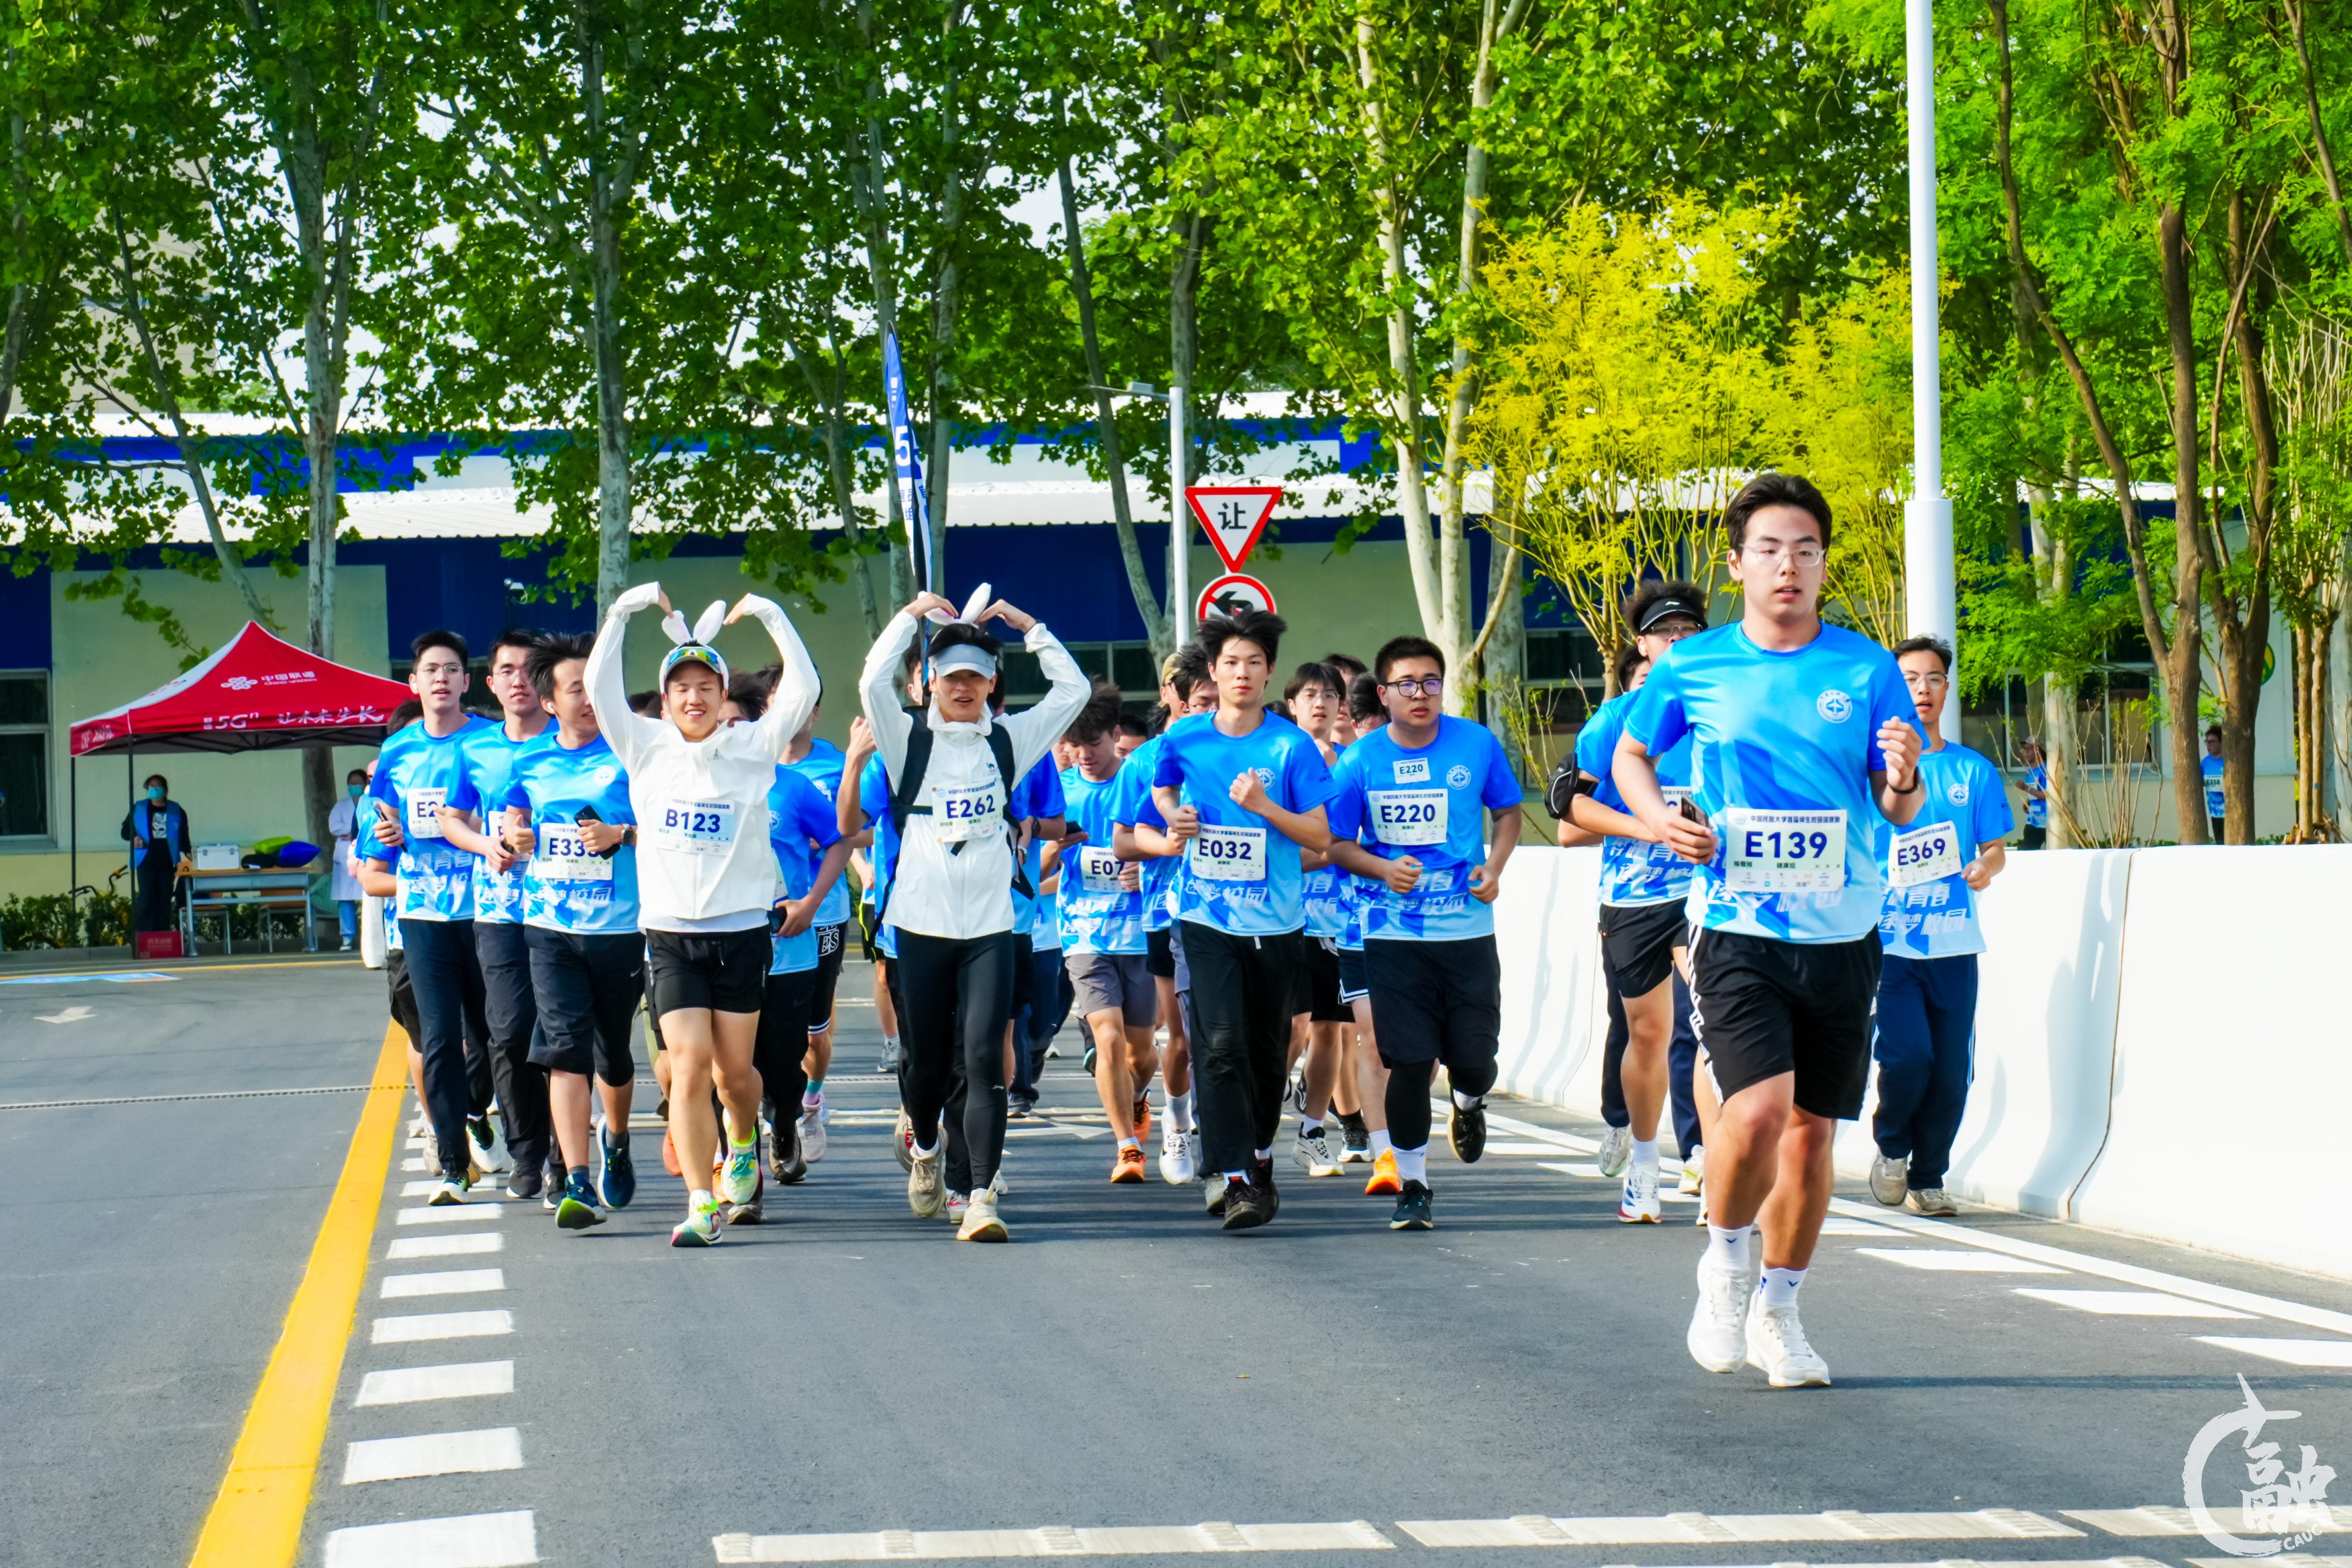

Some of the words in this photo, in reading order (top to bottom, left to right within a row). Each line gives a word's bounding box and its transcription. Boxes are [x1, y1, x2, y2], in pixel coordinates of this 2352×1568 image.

[1218, 502, 1247, 530] 让
[261, 671, 315, 681] 中国联通
[1400, 764, 1423, 774] E220
[417, 801, 447, 817] E2
[946, 794, 995, 819] E262
[1381, 804, 1435, 823] E220
[666, 808, 720, 833] B123
[1199, 838, 1252, 860] E032
[1746, 831, 1827, 859] E139
[1898, 838, 1946, 866] E369
